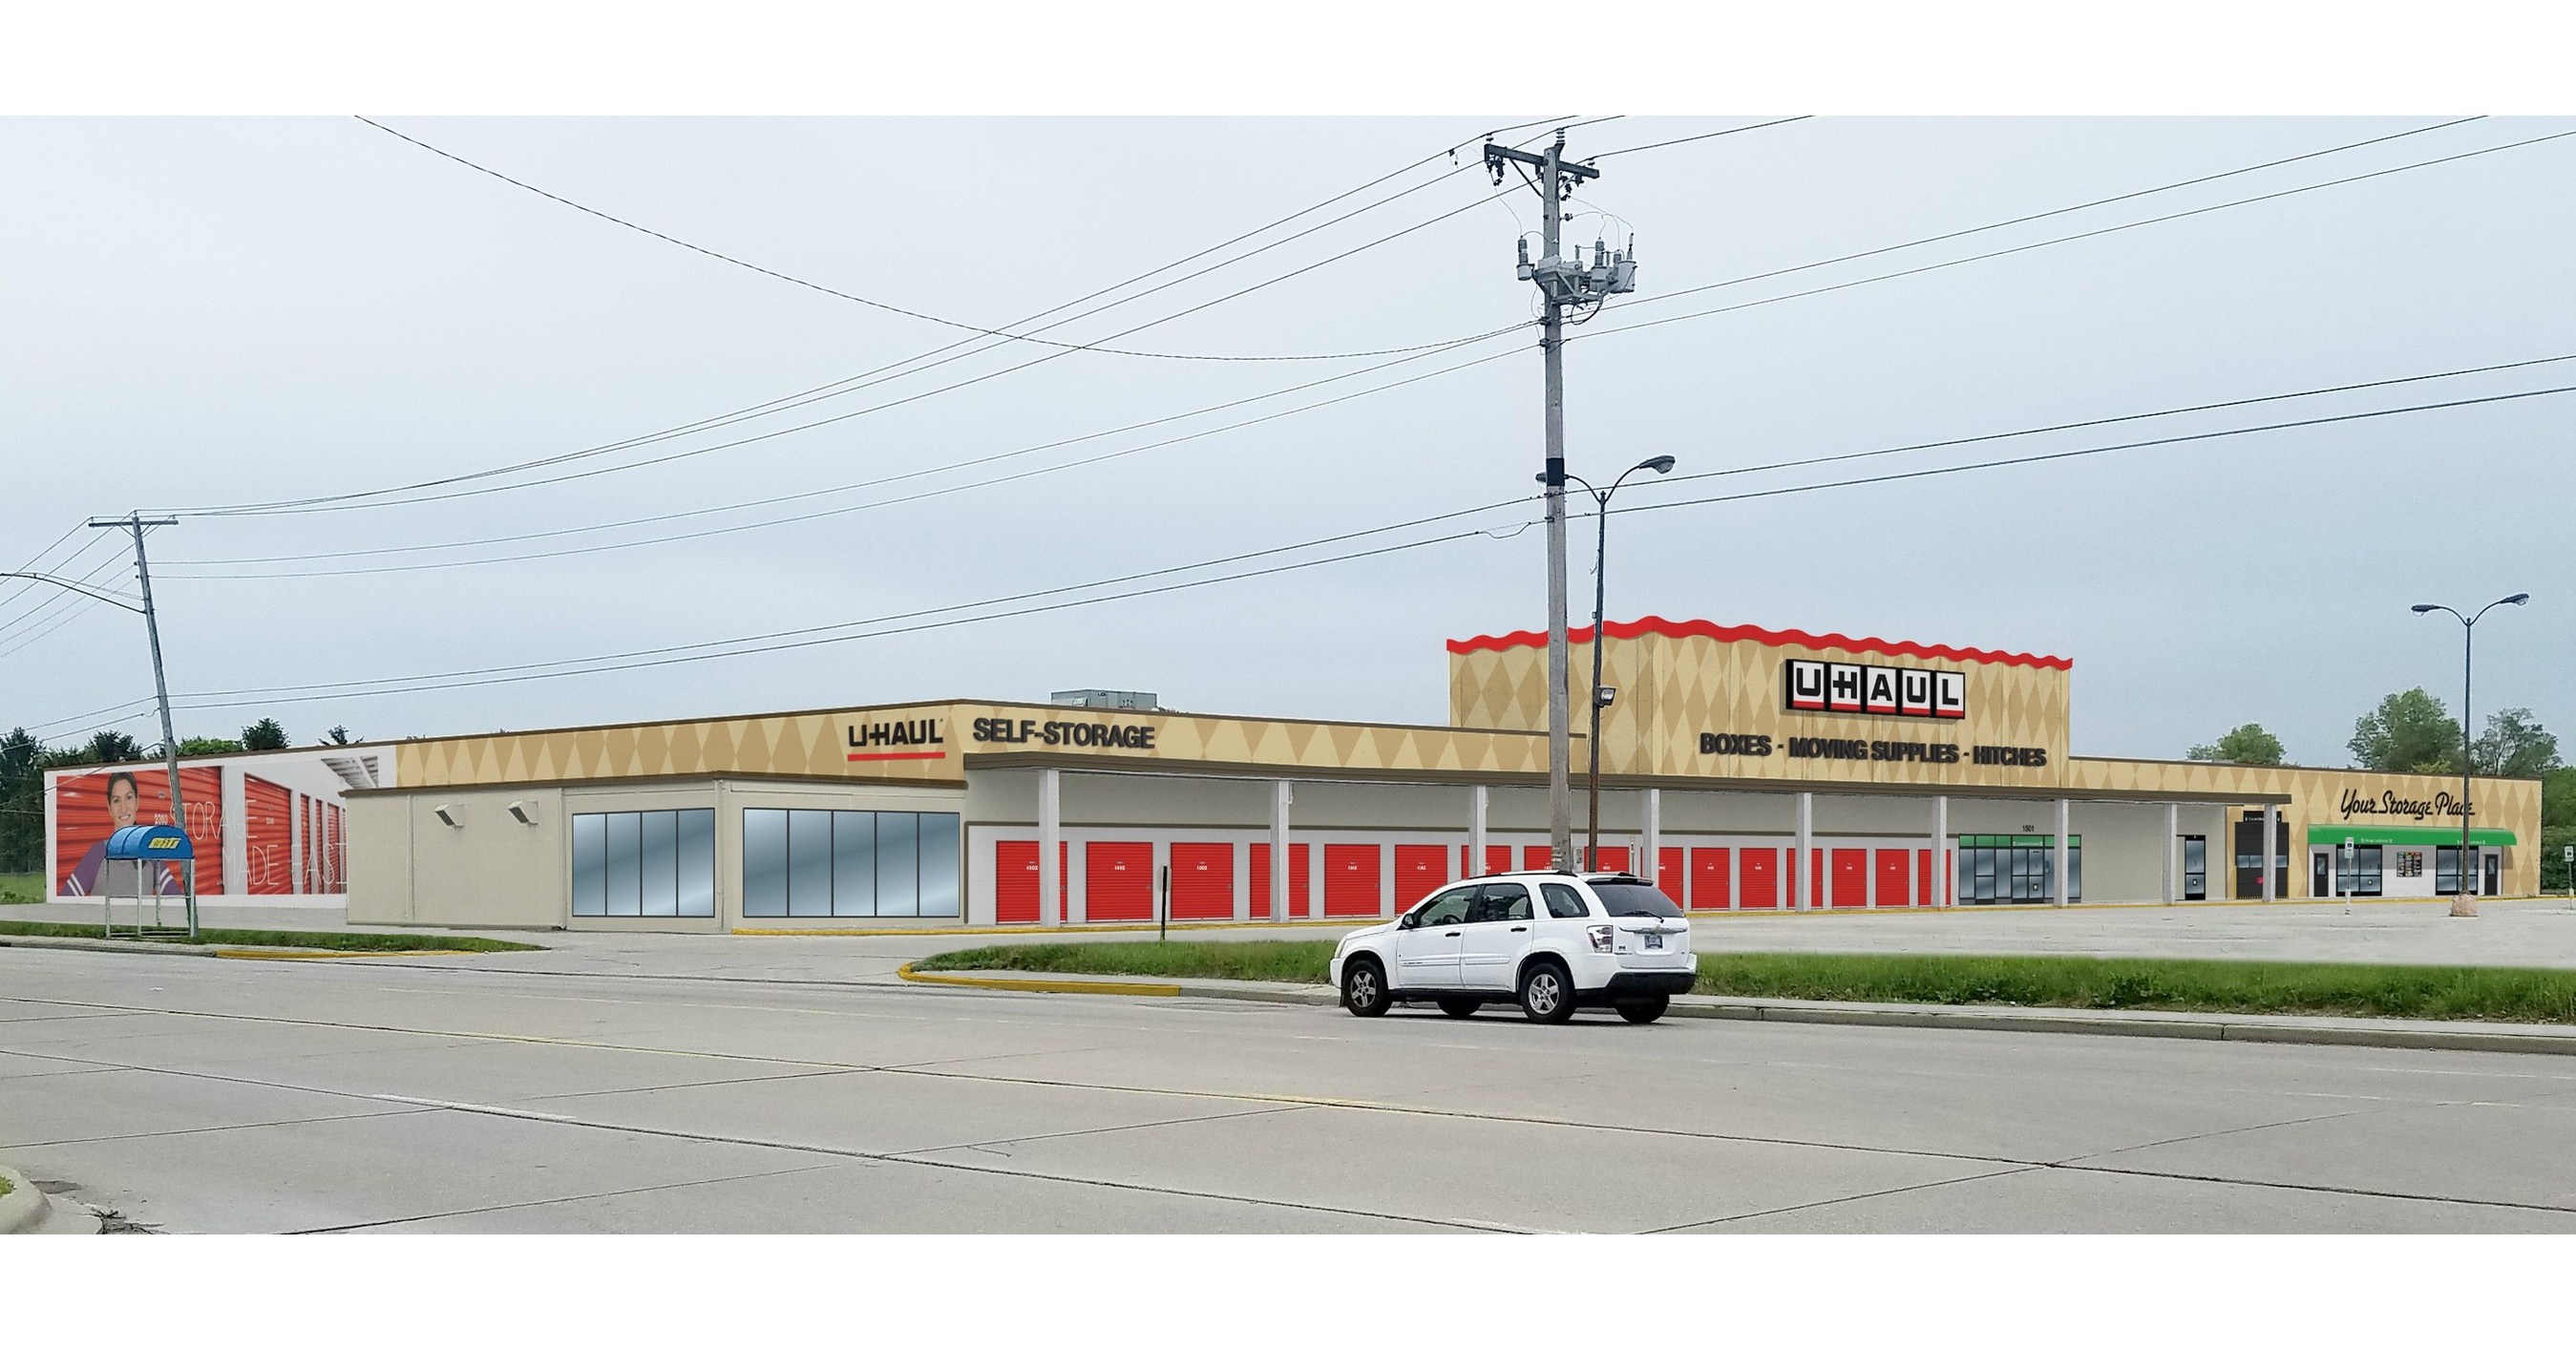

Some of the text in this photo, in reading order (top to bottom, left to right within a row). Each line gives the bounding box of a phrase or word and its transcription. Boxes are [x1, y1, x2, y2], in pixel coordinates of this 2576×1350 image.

[972, 716, 1156, 749] SELF-STORAGE
[1700, 732, 1772, 757] BOXES
[1788, 736, 1869, 761] MOVING
[1870, 740, 1960, 765] SUPPLIES
[1973, 745, 2047, 767] HITCHES
[2340, 789, 2378, 820] Your
[2377, 790, 2434, 821] Storage
[222, 844, 280, 886] MADE
